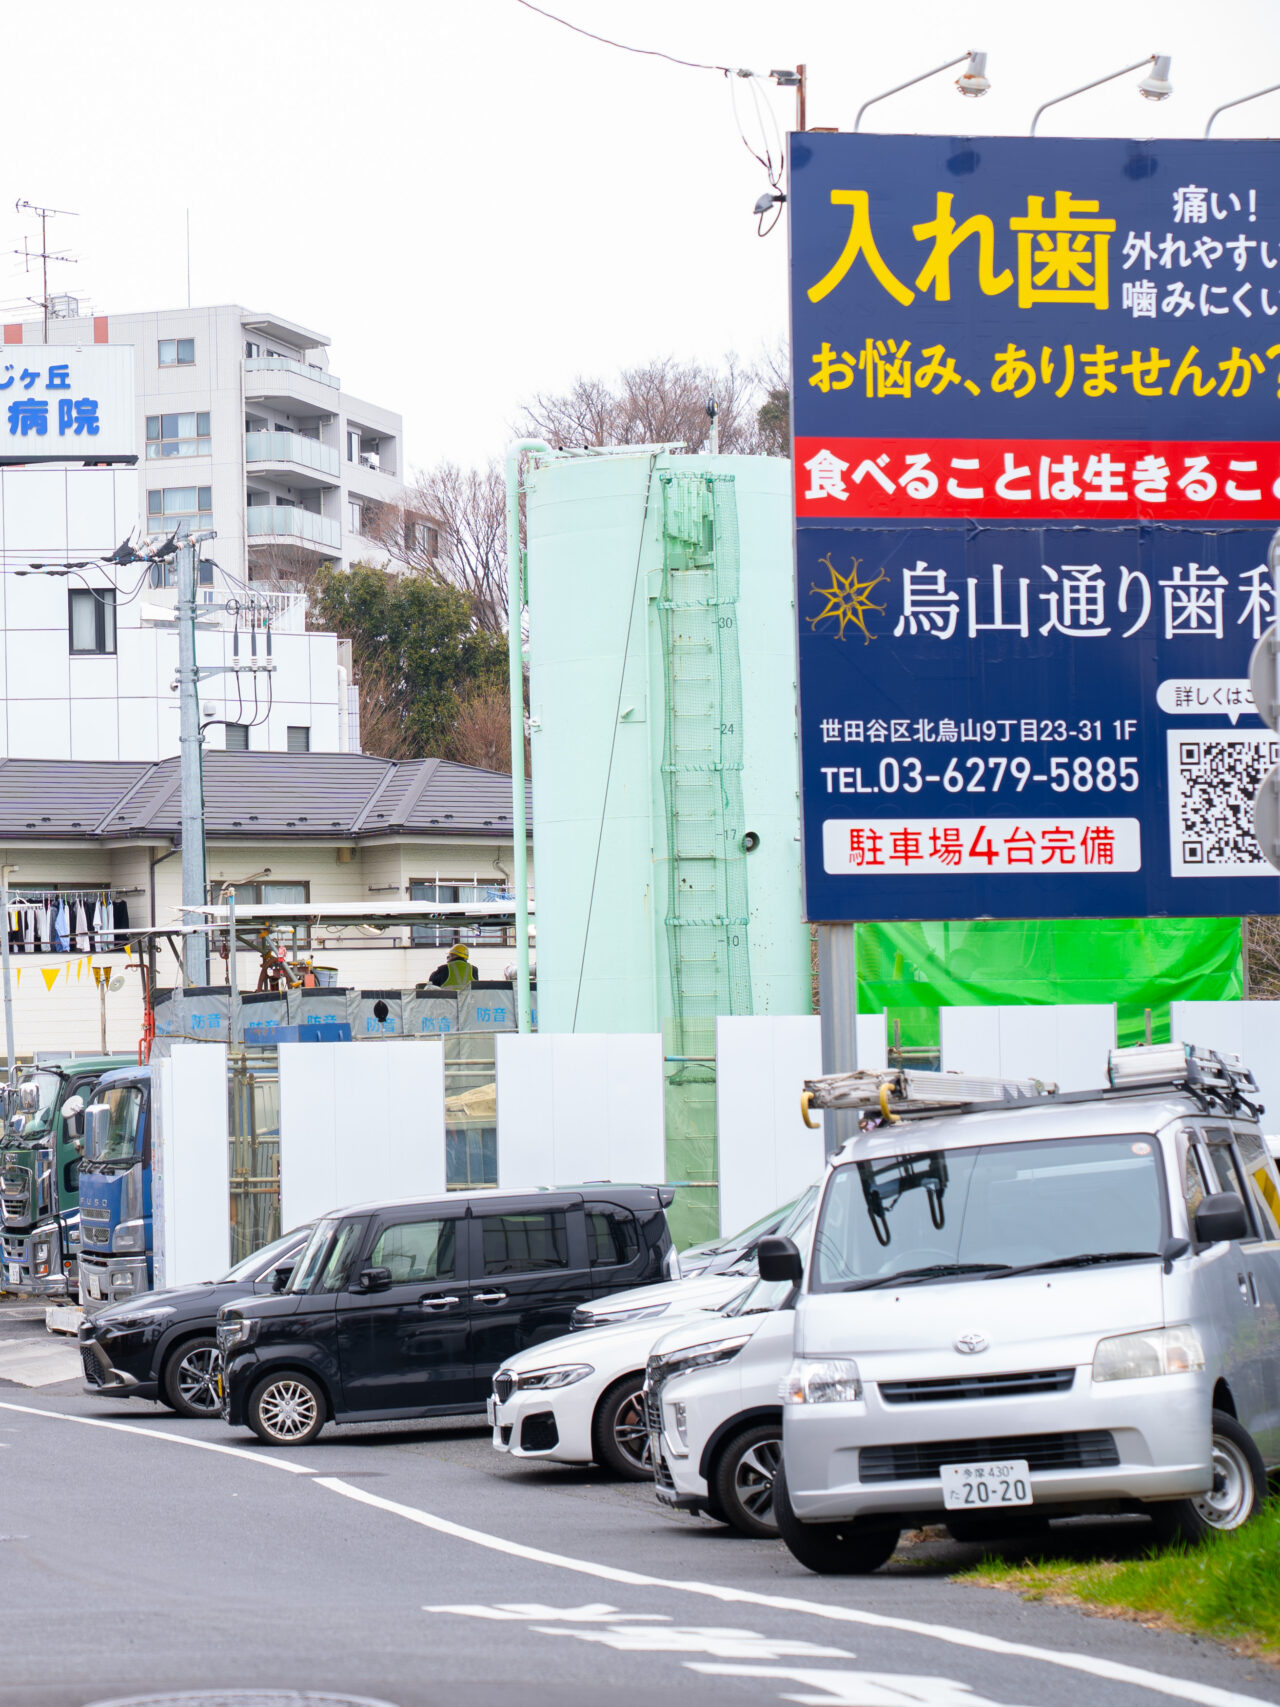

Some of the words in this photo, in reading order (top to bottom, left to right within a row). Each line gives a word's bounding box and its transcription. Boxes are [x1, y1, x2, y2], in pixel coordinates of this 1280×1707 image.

[1173, 184, 1257, 224] 痛い!
[806, 189, 1117, 310] 入れ歯
[804, 448, 1280, 503] 食べることは生きるこ
[1115, 720, 1137, 741] 1F
[820, 757, 1139, 794] TEL.03-6279-5885
[848, 825, 1115, 867] 駐車場4台完備
[191, 1012, 220, 1030] 防音
[421, 1016, 452, 1033] 防音
[476, 1007, 507, 1023] 防音
[988, 1465, 1010, 1478] 430
[962, 1479, 1027, 1504] 20-20
